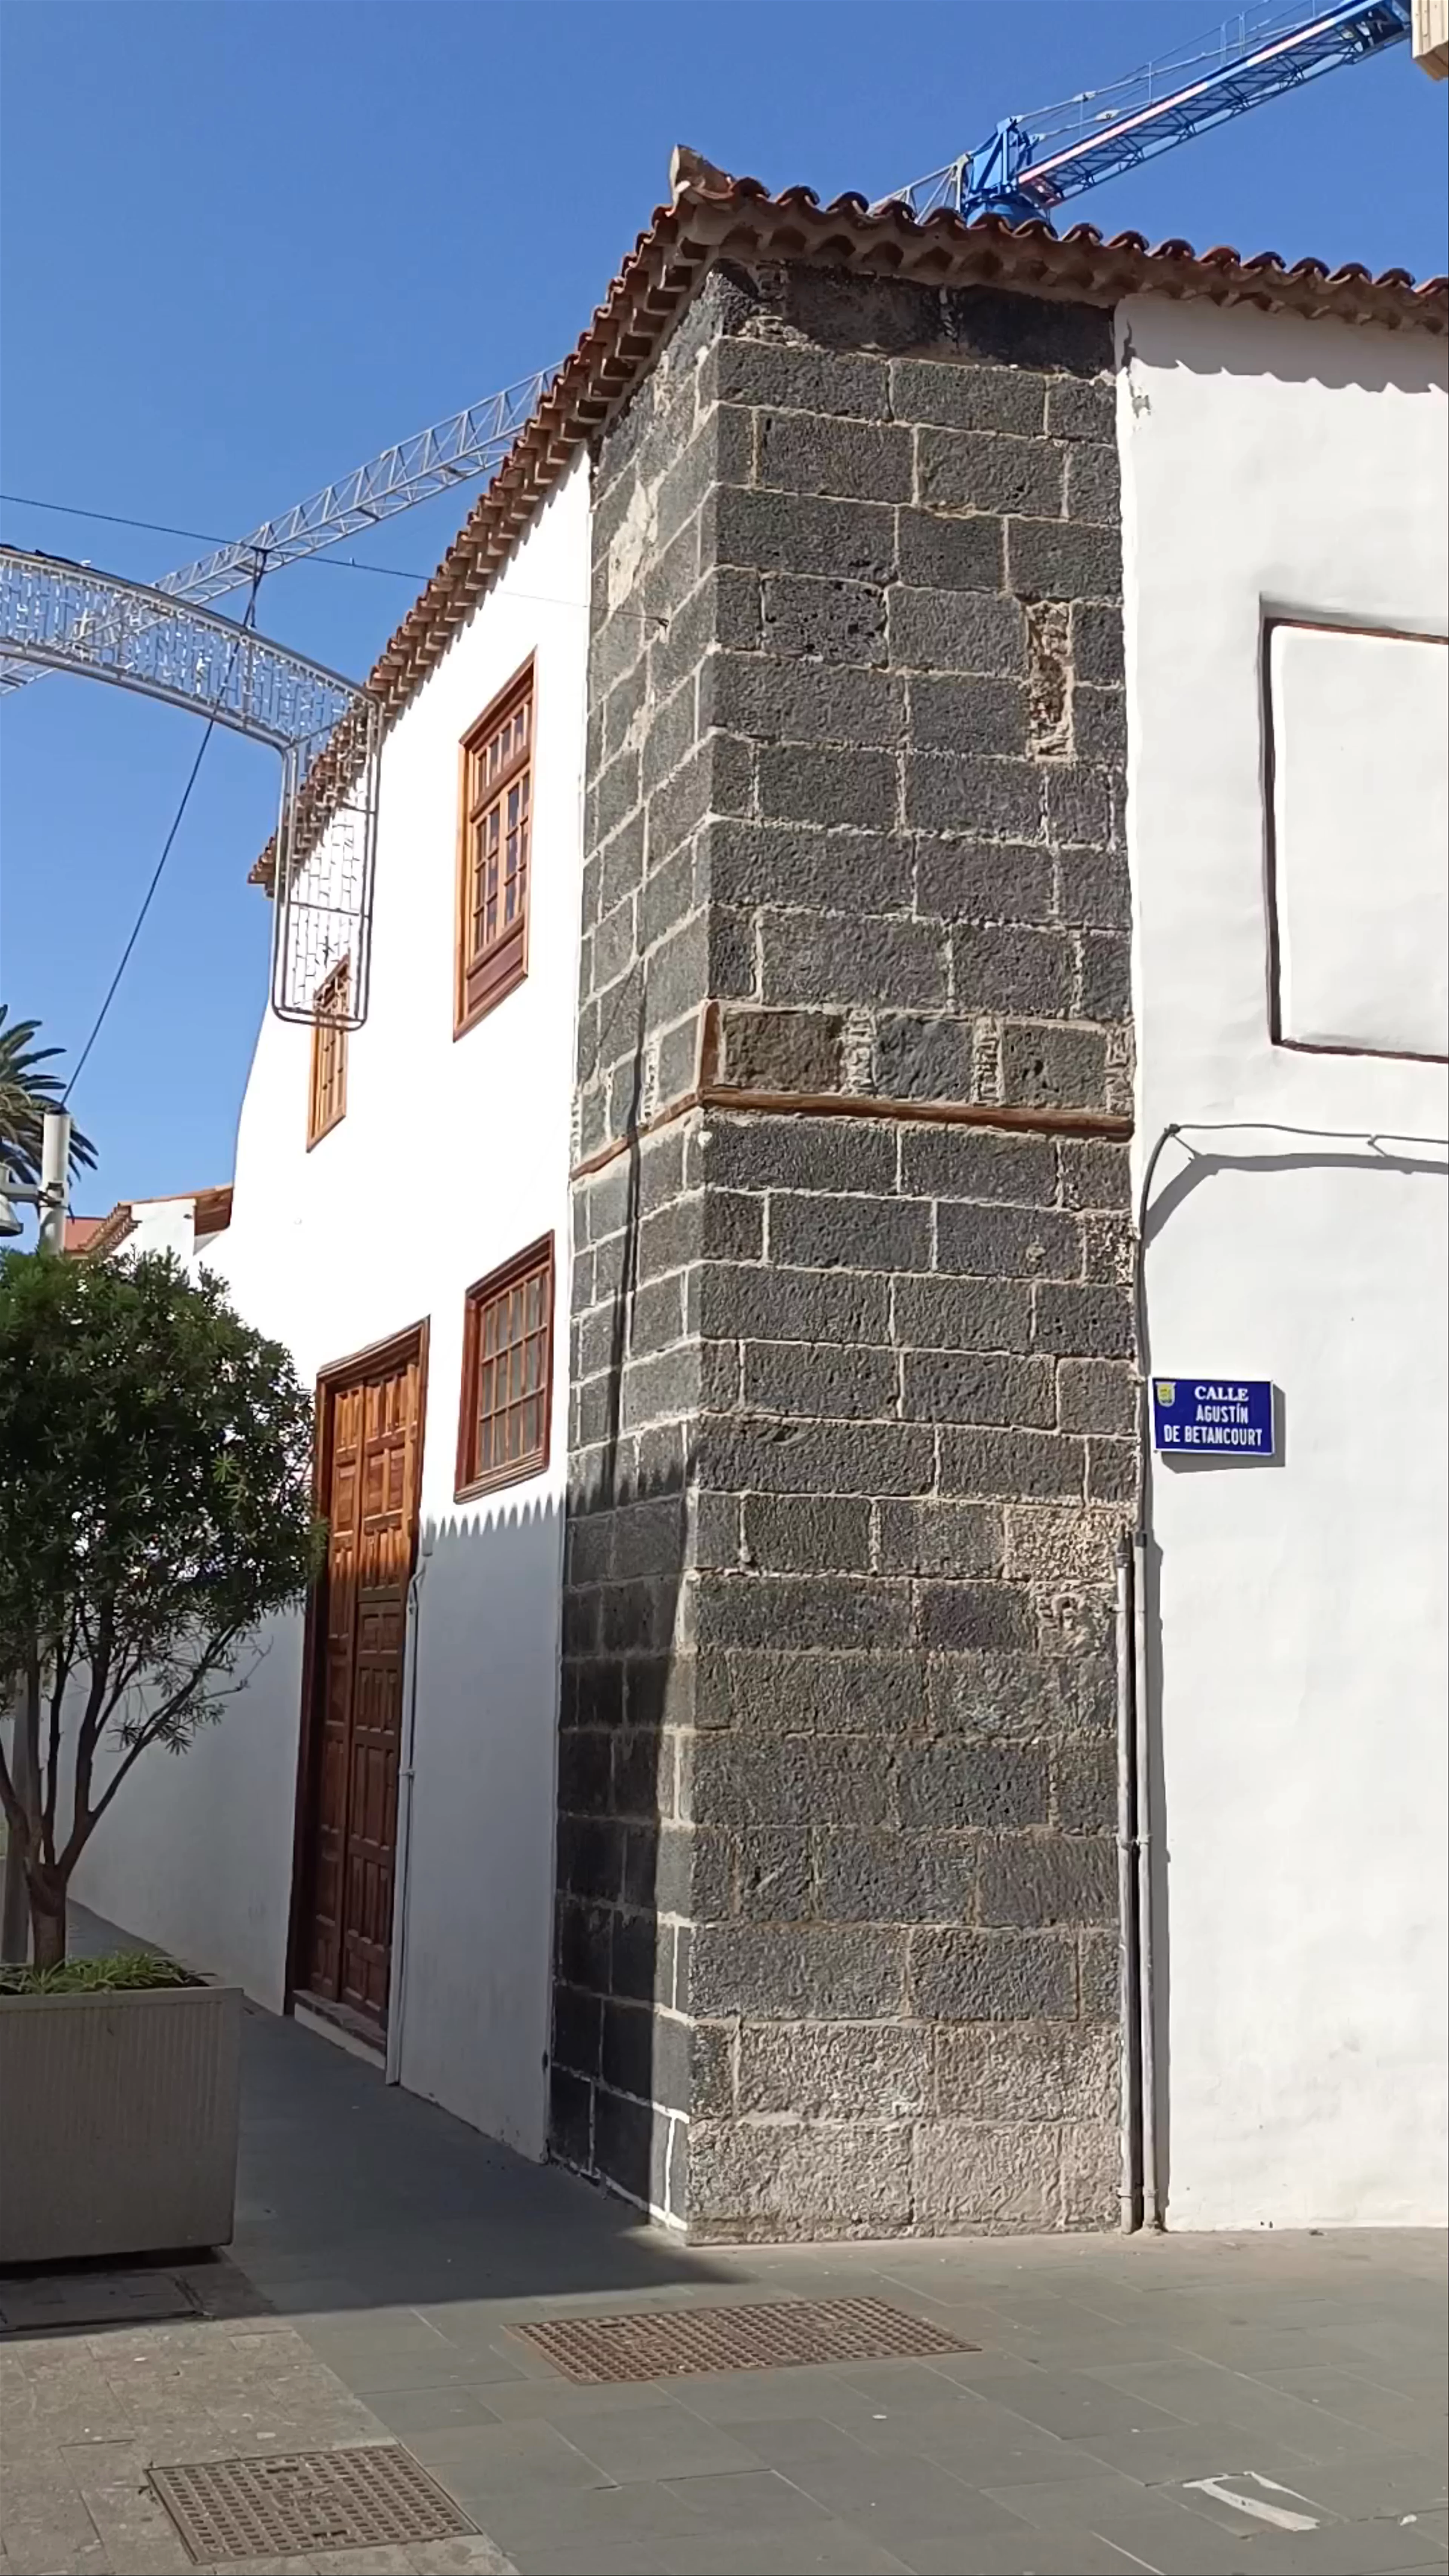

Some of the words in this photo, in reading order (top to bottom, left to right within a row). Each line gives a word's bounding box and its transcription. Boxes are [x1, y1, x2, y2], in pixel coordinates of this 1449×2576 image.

[1194, 1386, 1249, 1401] CALLE
[1195, 1403, 1248, 1424] AGUSTÍN
[1163, 1424, 1181, 1443] DE
[1184, 1425, 1263, 1446] BETANCOURT
